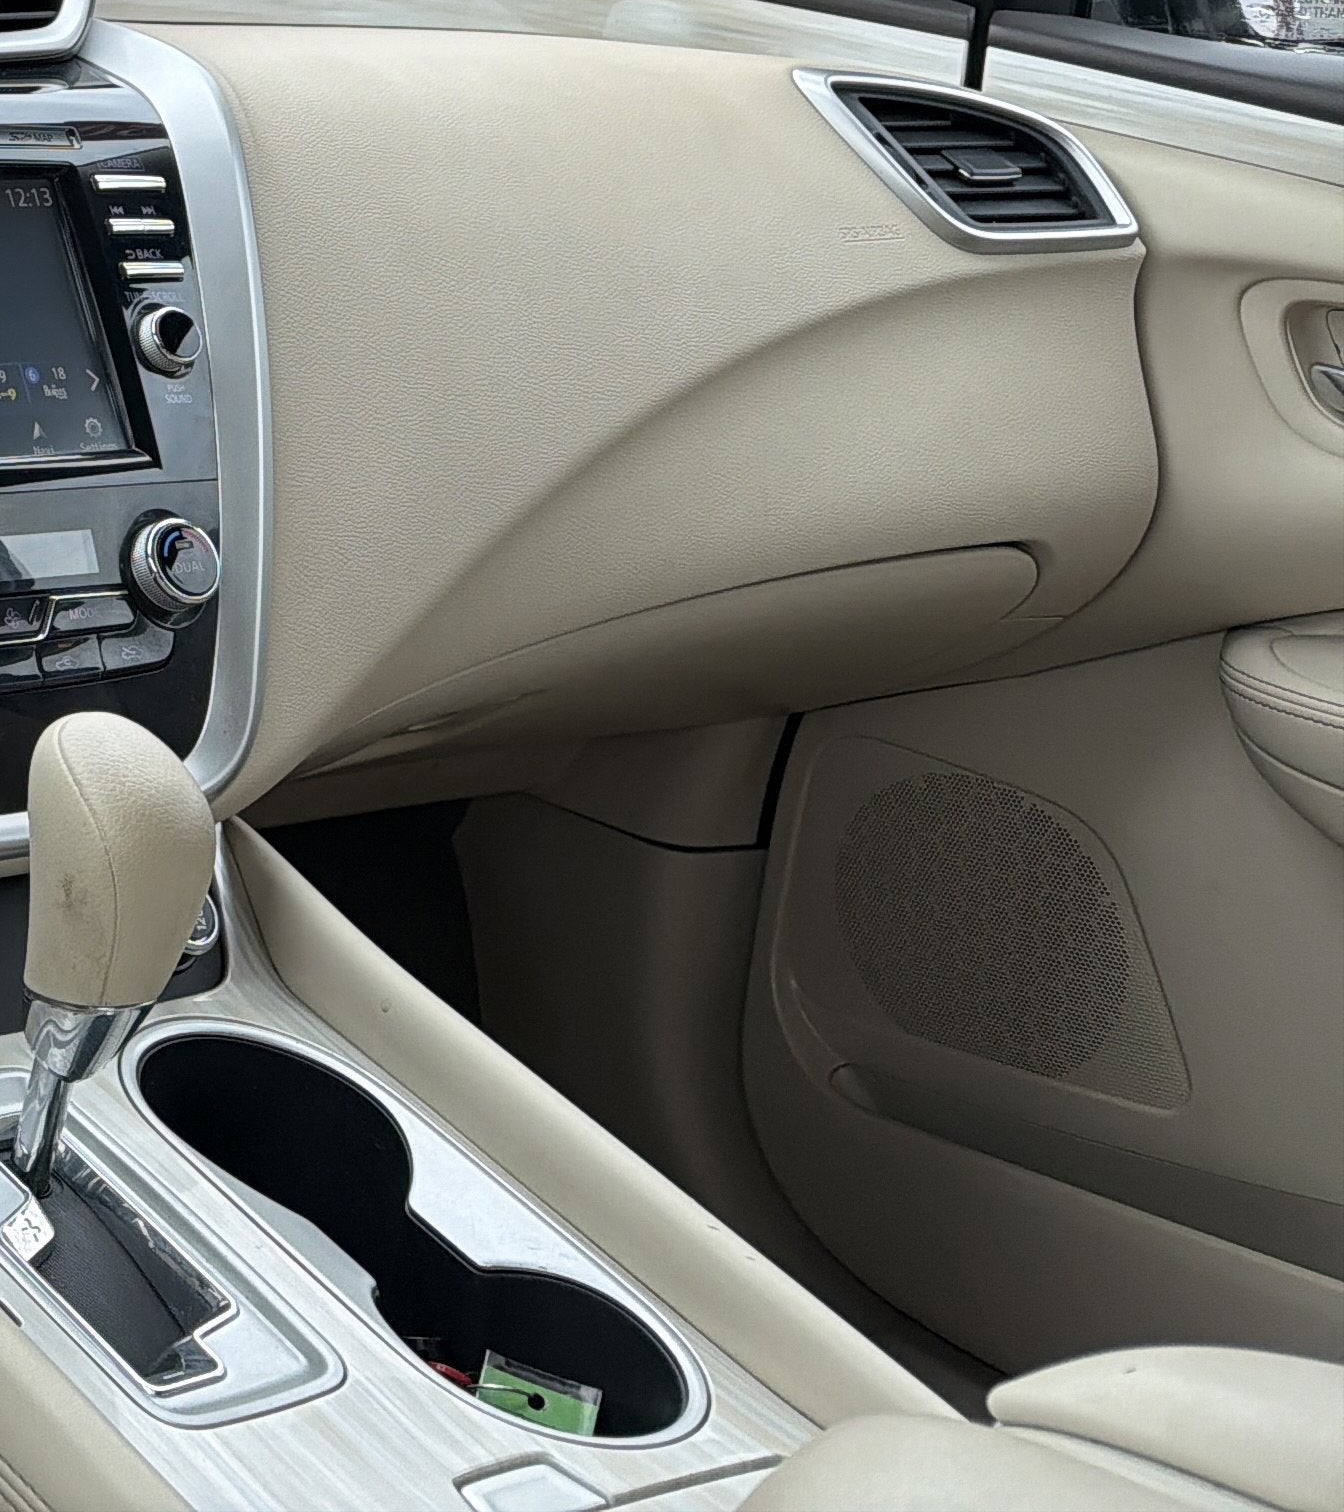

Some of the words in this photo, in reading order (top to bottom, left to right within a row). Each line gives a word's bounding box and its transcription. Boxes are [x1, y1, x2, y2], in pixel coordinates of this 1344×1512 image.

[101, 157, 141, 168] CAMERA
[5, 188, 53, 207] 12:13
[136, 249, 163, 259] BACK
[51, 366, 67, 380] 18
[175, 562, 206, 573] DUAL
[69, 607, 97, 620] MOD
